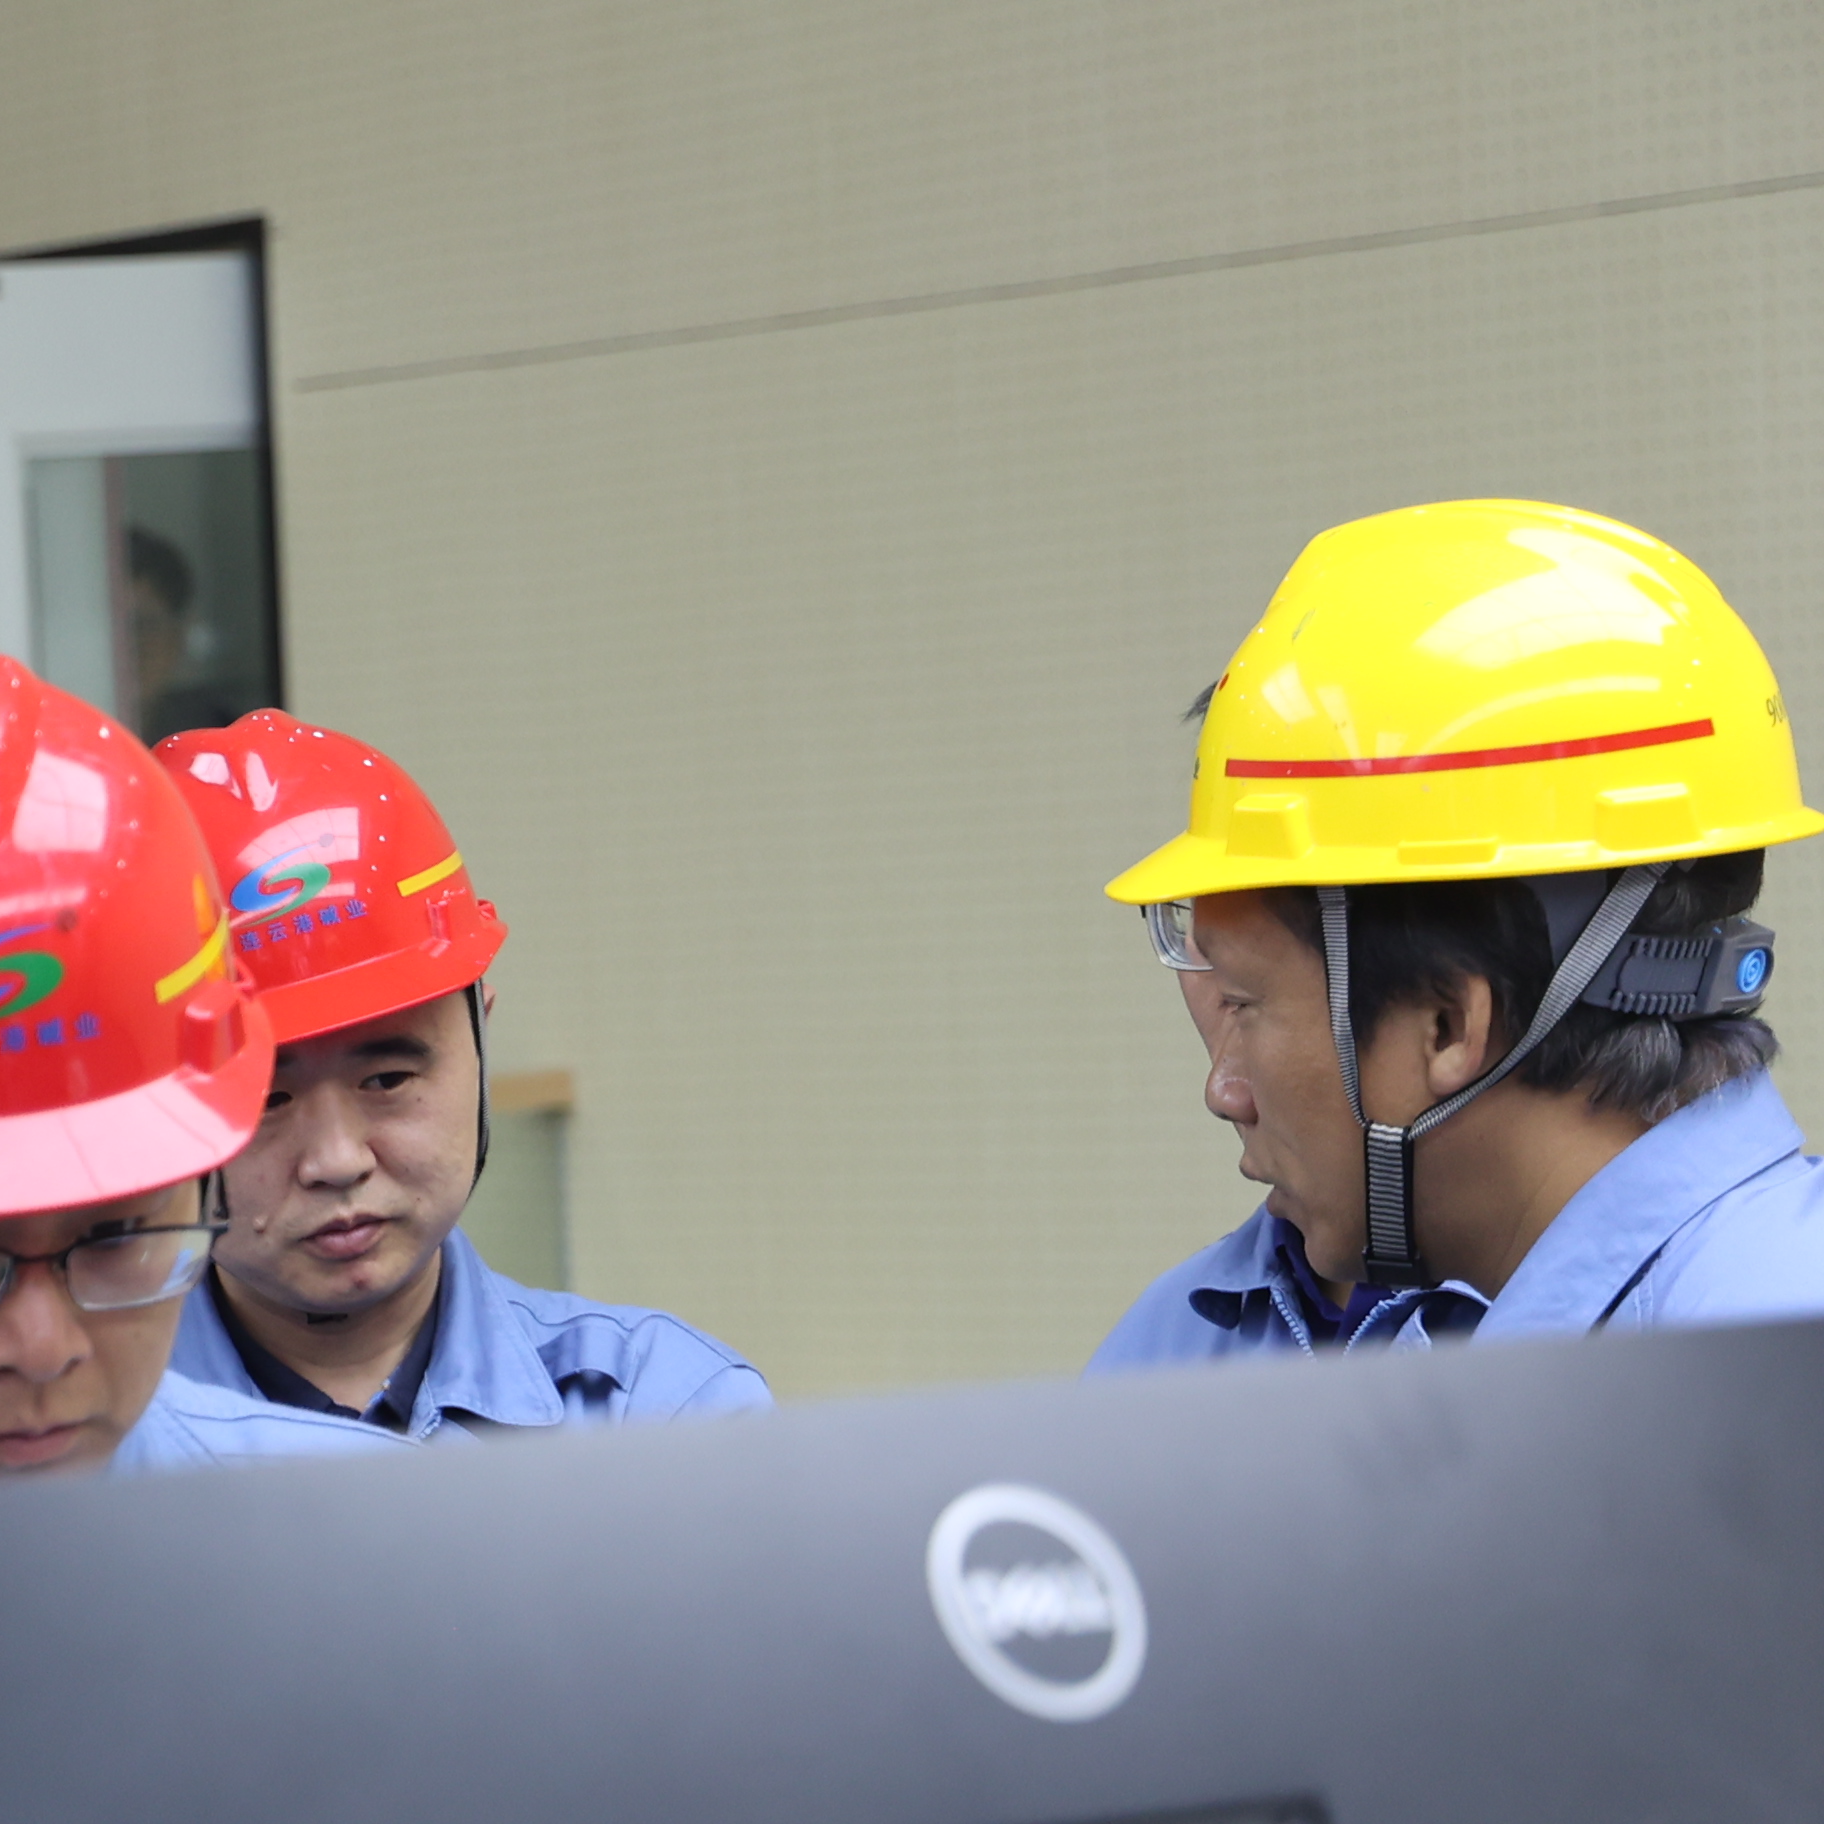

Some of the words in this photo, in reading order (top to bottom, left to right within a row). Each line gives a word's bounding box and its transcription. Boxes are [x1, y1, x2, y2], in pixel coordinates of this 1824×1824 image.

[238, 898, 368, 952] 连云港碱业
